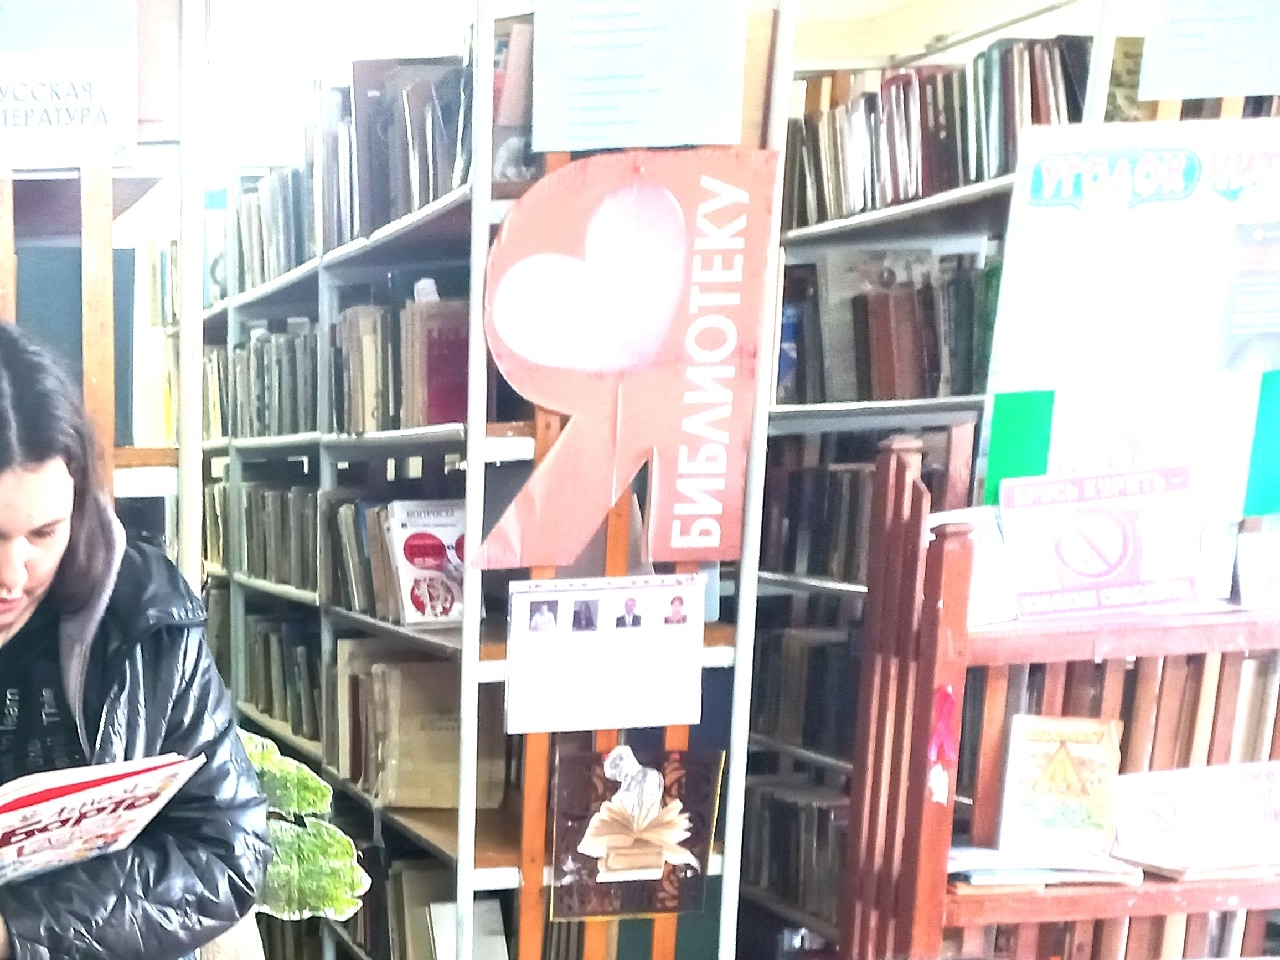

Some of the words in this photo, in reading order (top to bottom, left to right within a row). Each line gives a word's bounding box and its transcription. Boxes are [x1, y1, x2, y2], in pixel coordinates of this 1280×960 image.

[670, 175, 750, 549] БИБЛИОТЕКУ
[1014, 478, 1079, 508] БРОСЬ
[1083, 473, 1167, 500] КУРИТЬ
